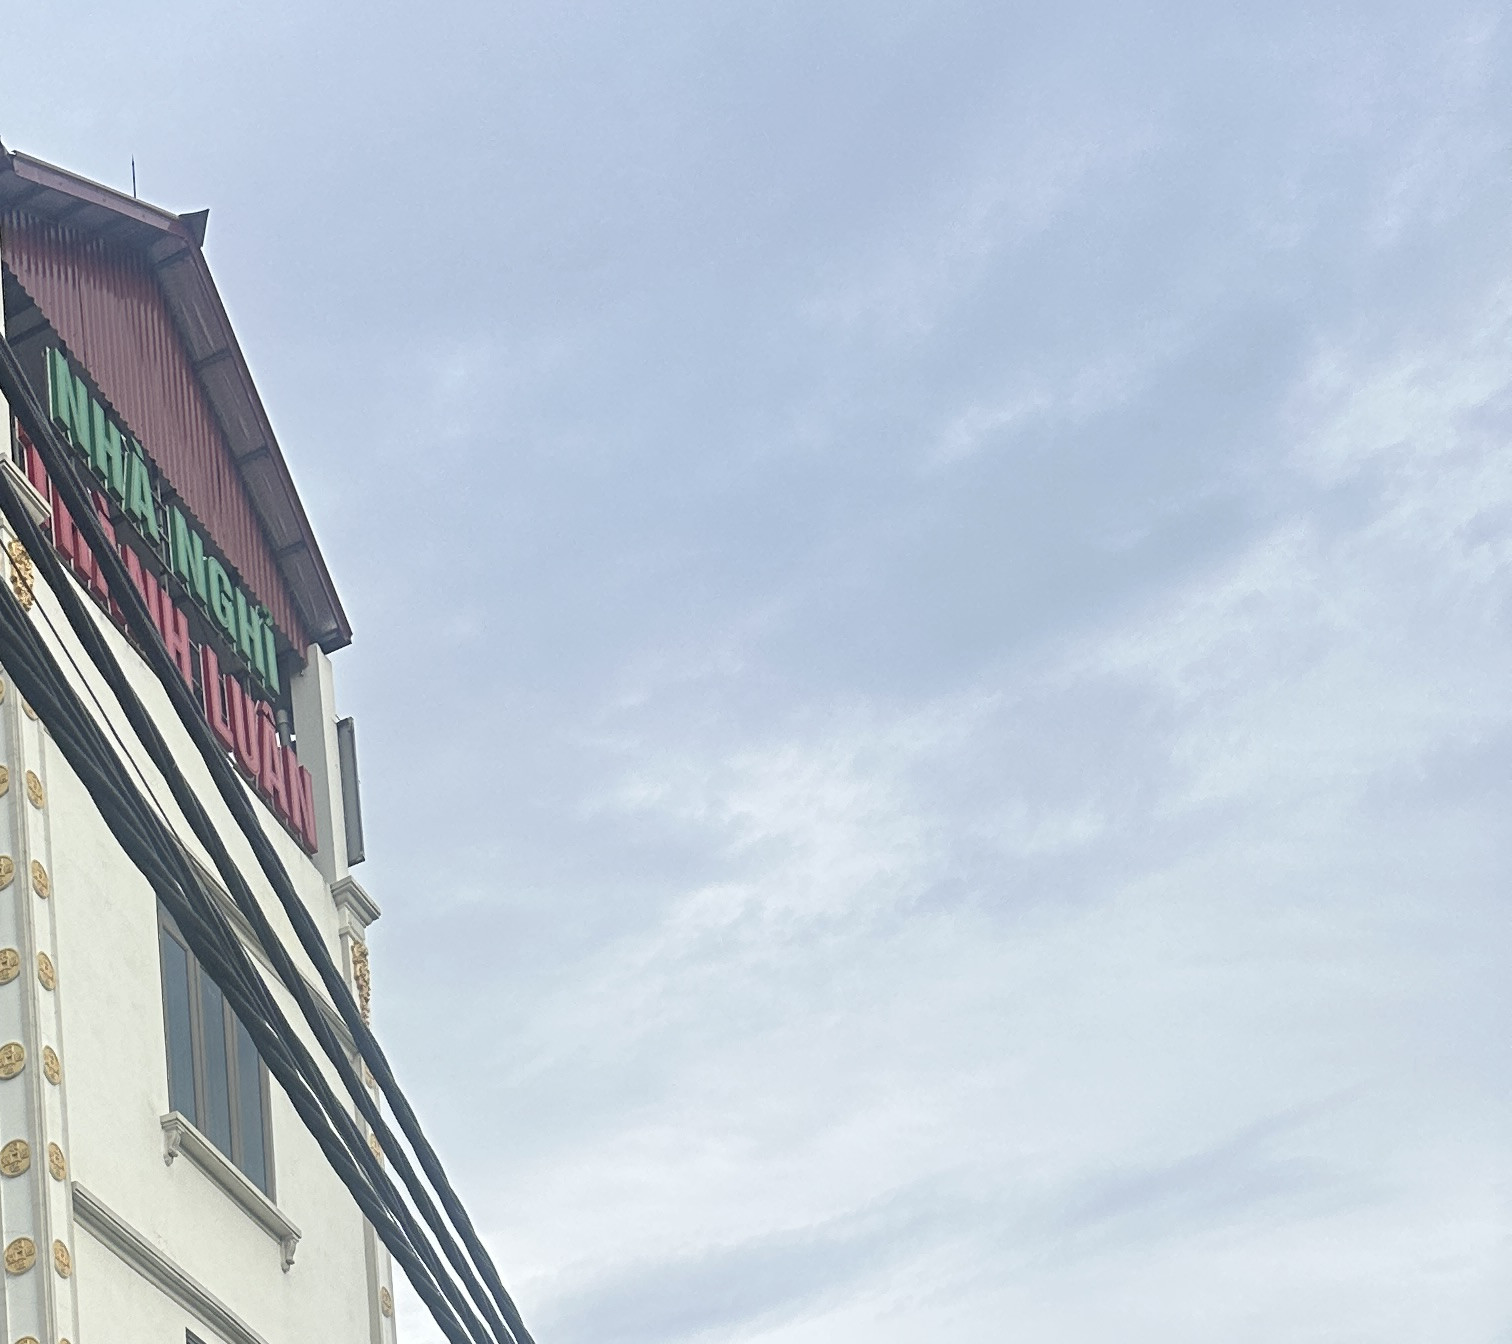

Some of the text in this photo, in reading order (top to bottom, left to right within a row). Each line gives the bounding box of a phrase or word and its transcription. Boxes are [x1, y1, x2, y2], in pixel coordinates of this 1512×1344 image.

[46, 346, 281, 696] NHÀ NGHỈ
[199, 642, 319, 856] LUÂN
